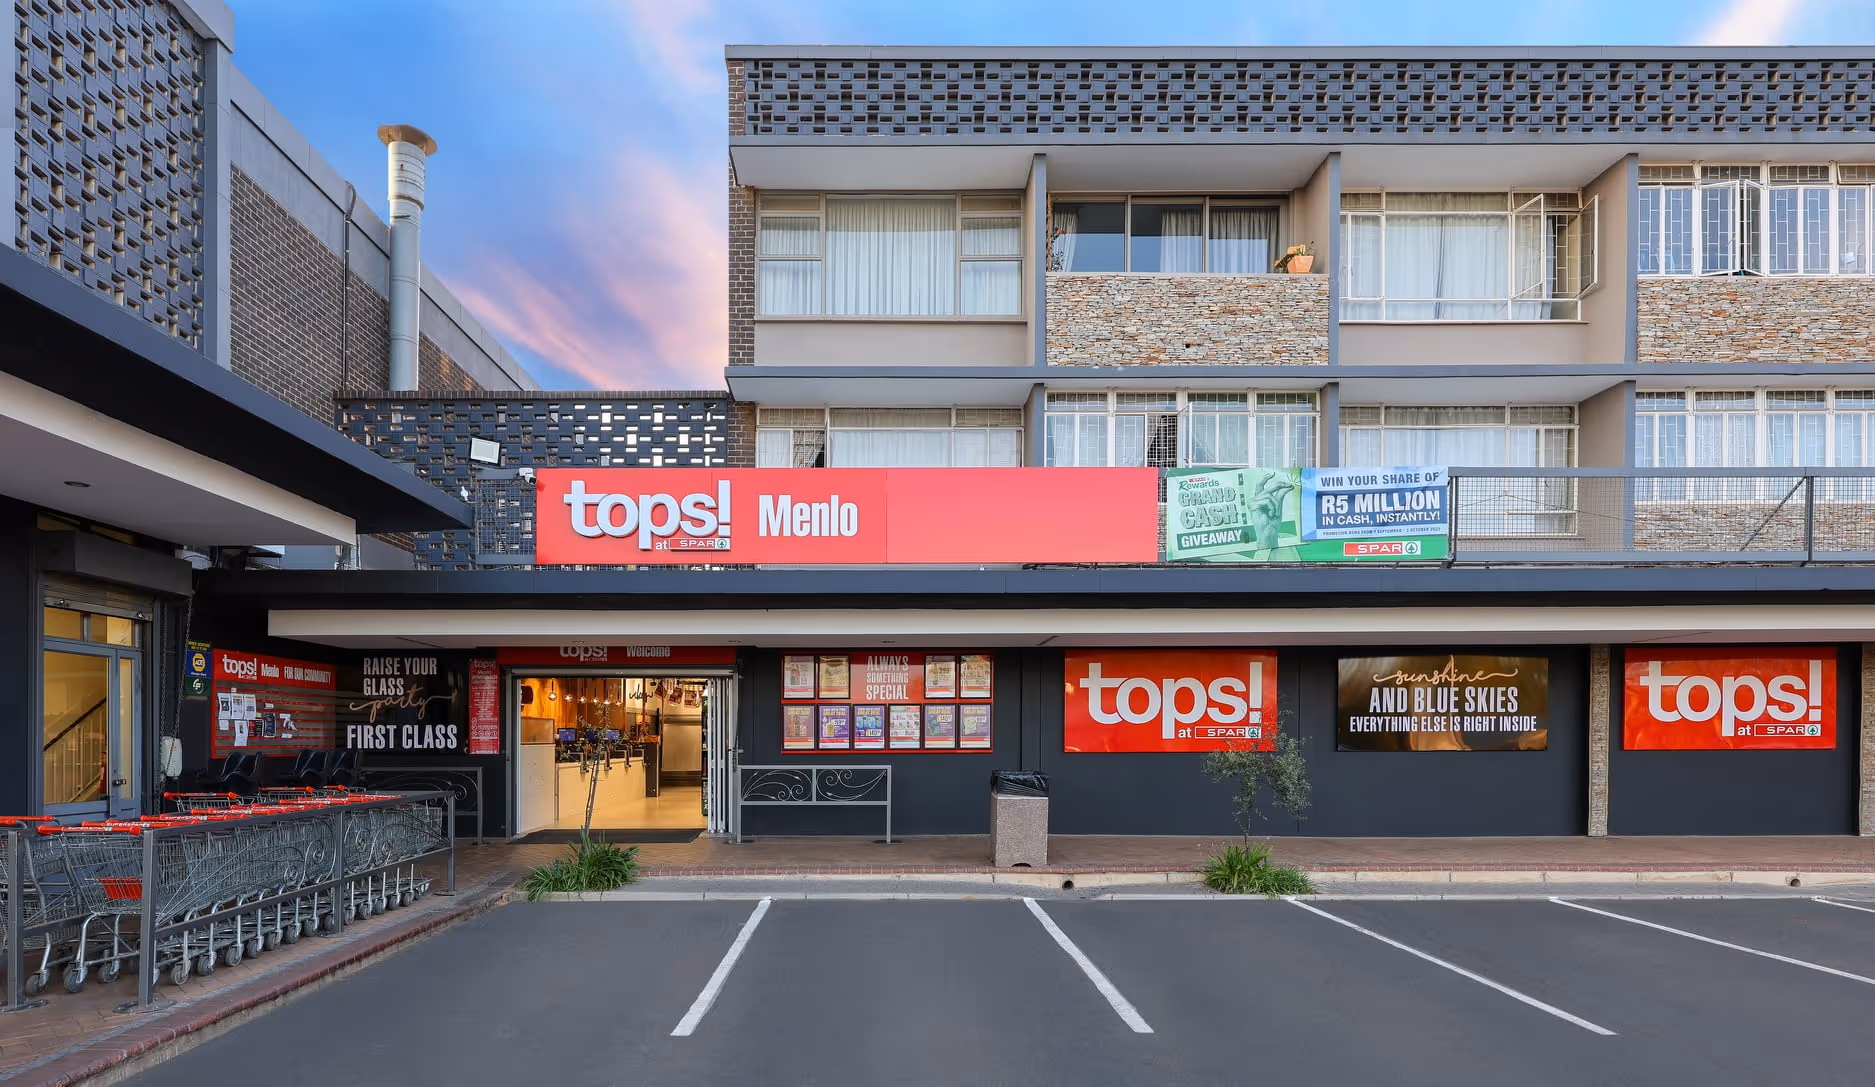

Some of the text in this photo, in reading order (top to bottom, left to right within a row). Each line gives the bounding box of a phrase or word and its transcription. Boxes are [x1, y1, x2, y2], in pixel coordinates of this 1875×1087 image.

[1178, 478, 1220, 491] Rewards
[1321, 472, 1439, 487] WIN YOUR SHARE OF
[1178, 487, 1236, 507] GRAND
[1322, 490, 1440, 515] R5 MILLION
[563, 480, 731, 550] tops!
[758, 495, 858, 537] Menlo
[1180, 504, 1238, 530] CASH
[1322, 512, 1440, 526] IN CASH, INSTANTLY!
[655, 540, 715, 550] at SPAR
[1181, 530, 1242, 548] GIVEAWAY
[1357, 544, 1402, 554] SPAR
[626, 646, 670, 657] Welcome
[222, 654, 257, 679] tops!
[261, 664, 280, 678] Menlo
[363, 657, 438, 675] RAISE YOUR
[866, 656, 909, 672] ALWAYS
[1373, 655, 1519, 686] sunshine
[284, 666, 332, 684] FOR OUR COMMUNITY
[866, 672, 909, 684] SOMETHING
[363, 678, 404, 696] GLASS
[866, 685, 909, 700] SPECIAL
[349, 684, 458, 722] party
[1080, 662, 1262, 739] tops!
[1369, 686, 1519, 713] AND BLUE SKIES
[1640, 660, 1822, 737] tops!
[1178, 727, 1246, 738] at SPAR
[1350, 716, 1537, 732] EVERYTHING ELSE IS RIGHT INSIDE
[1737, 725, 1804, 736] at SPAR
[346, 724, 458, 750] FIRST CLASS
